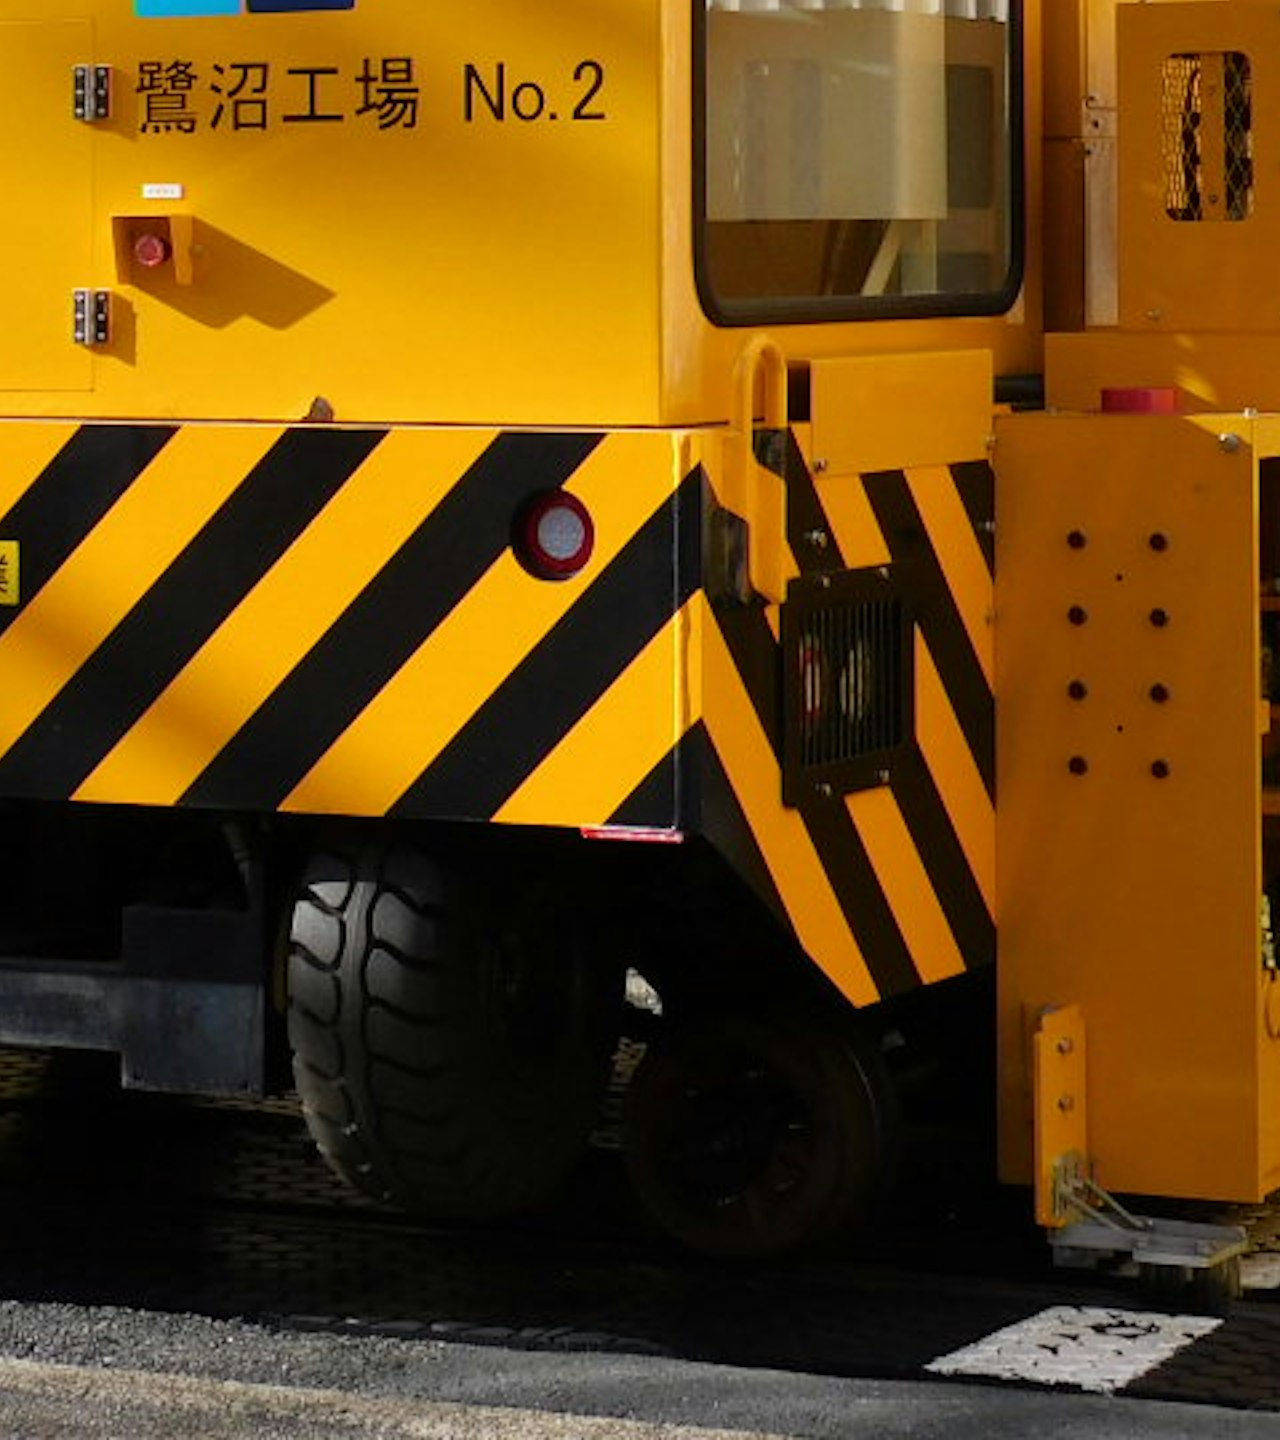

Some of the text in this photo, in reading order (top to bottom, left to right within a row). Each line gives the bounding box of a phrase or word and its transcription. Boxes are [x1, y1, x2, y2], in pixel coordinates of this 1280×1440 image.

[136, 57, 607, 134] 鷺沼工場 No.2
